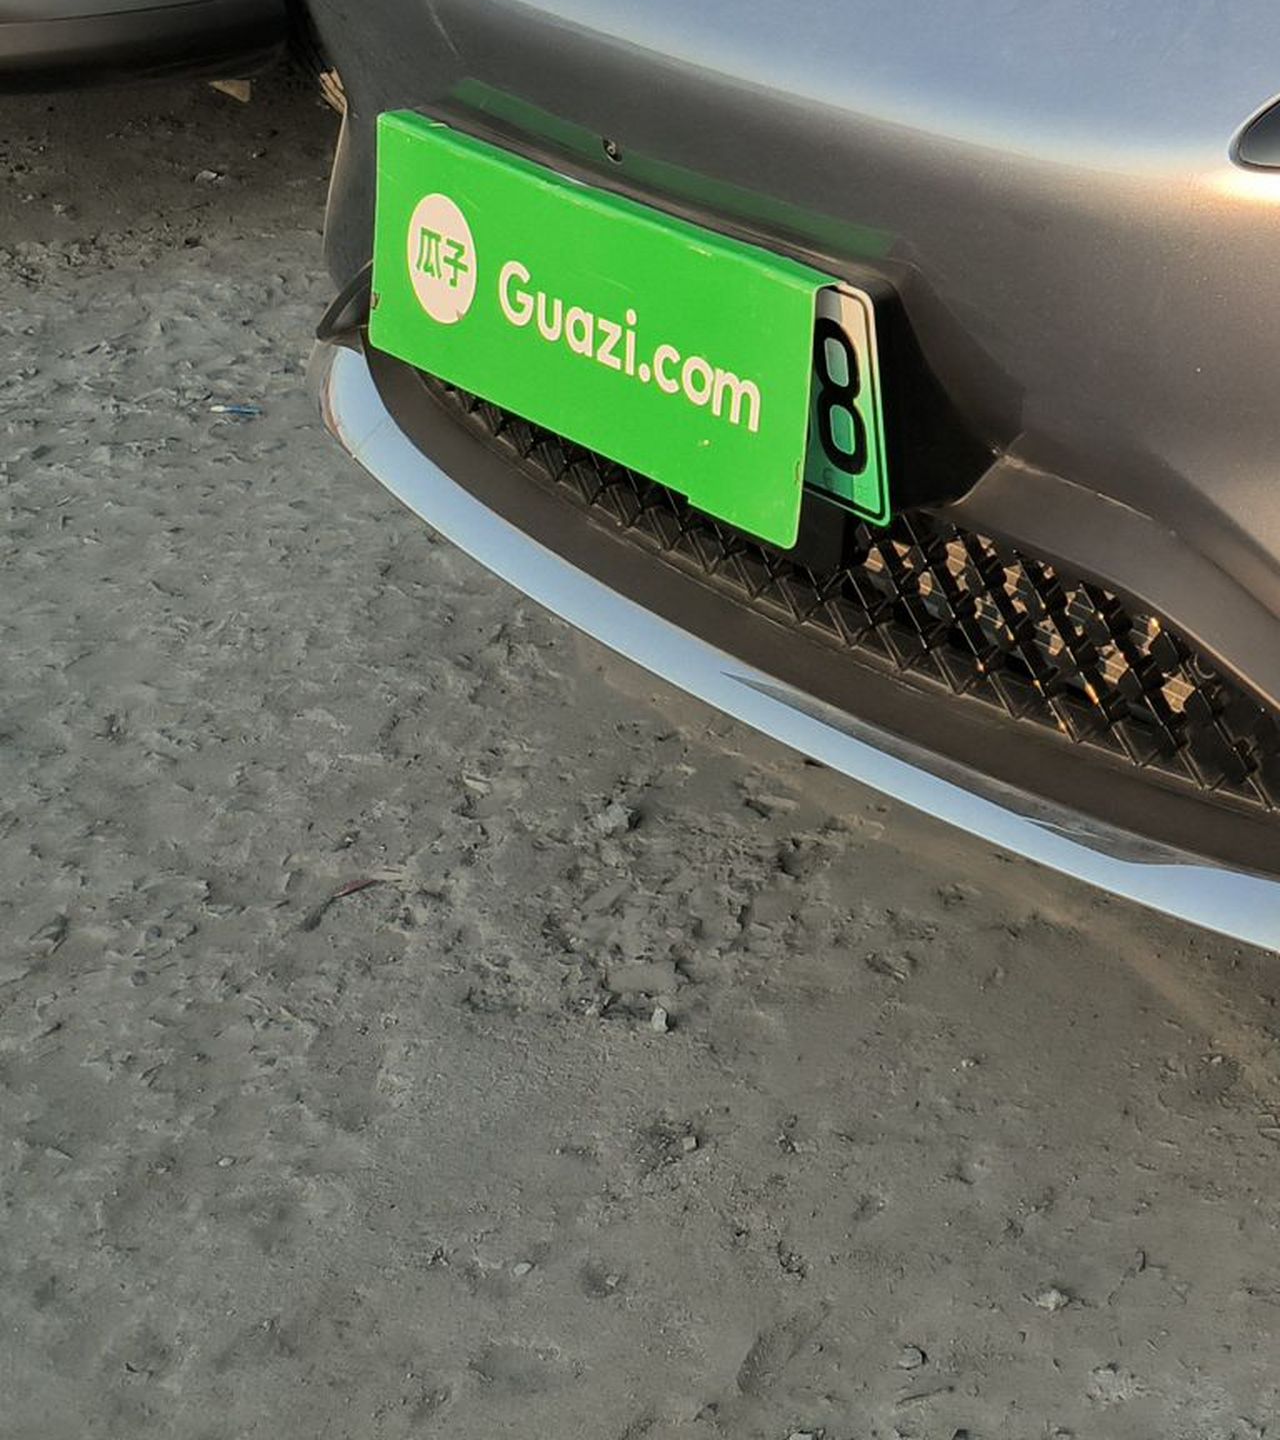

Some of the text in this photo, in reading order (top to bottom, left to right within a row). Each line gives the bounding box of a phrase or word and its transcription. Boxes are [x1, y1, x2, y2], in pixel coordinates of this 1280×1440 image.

[416, 226, 469, 288] 瓜子
[499, 260, 761, 433] Guazi.com
[814, 317, 868, 476] 8
